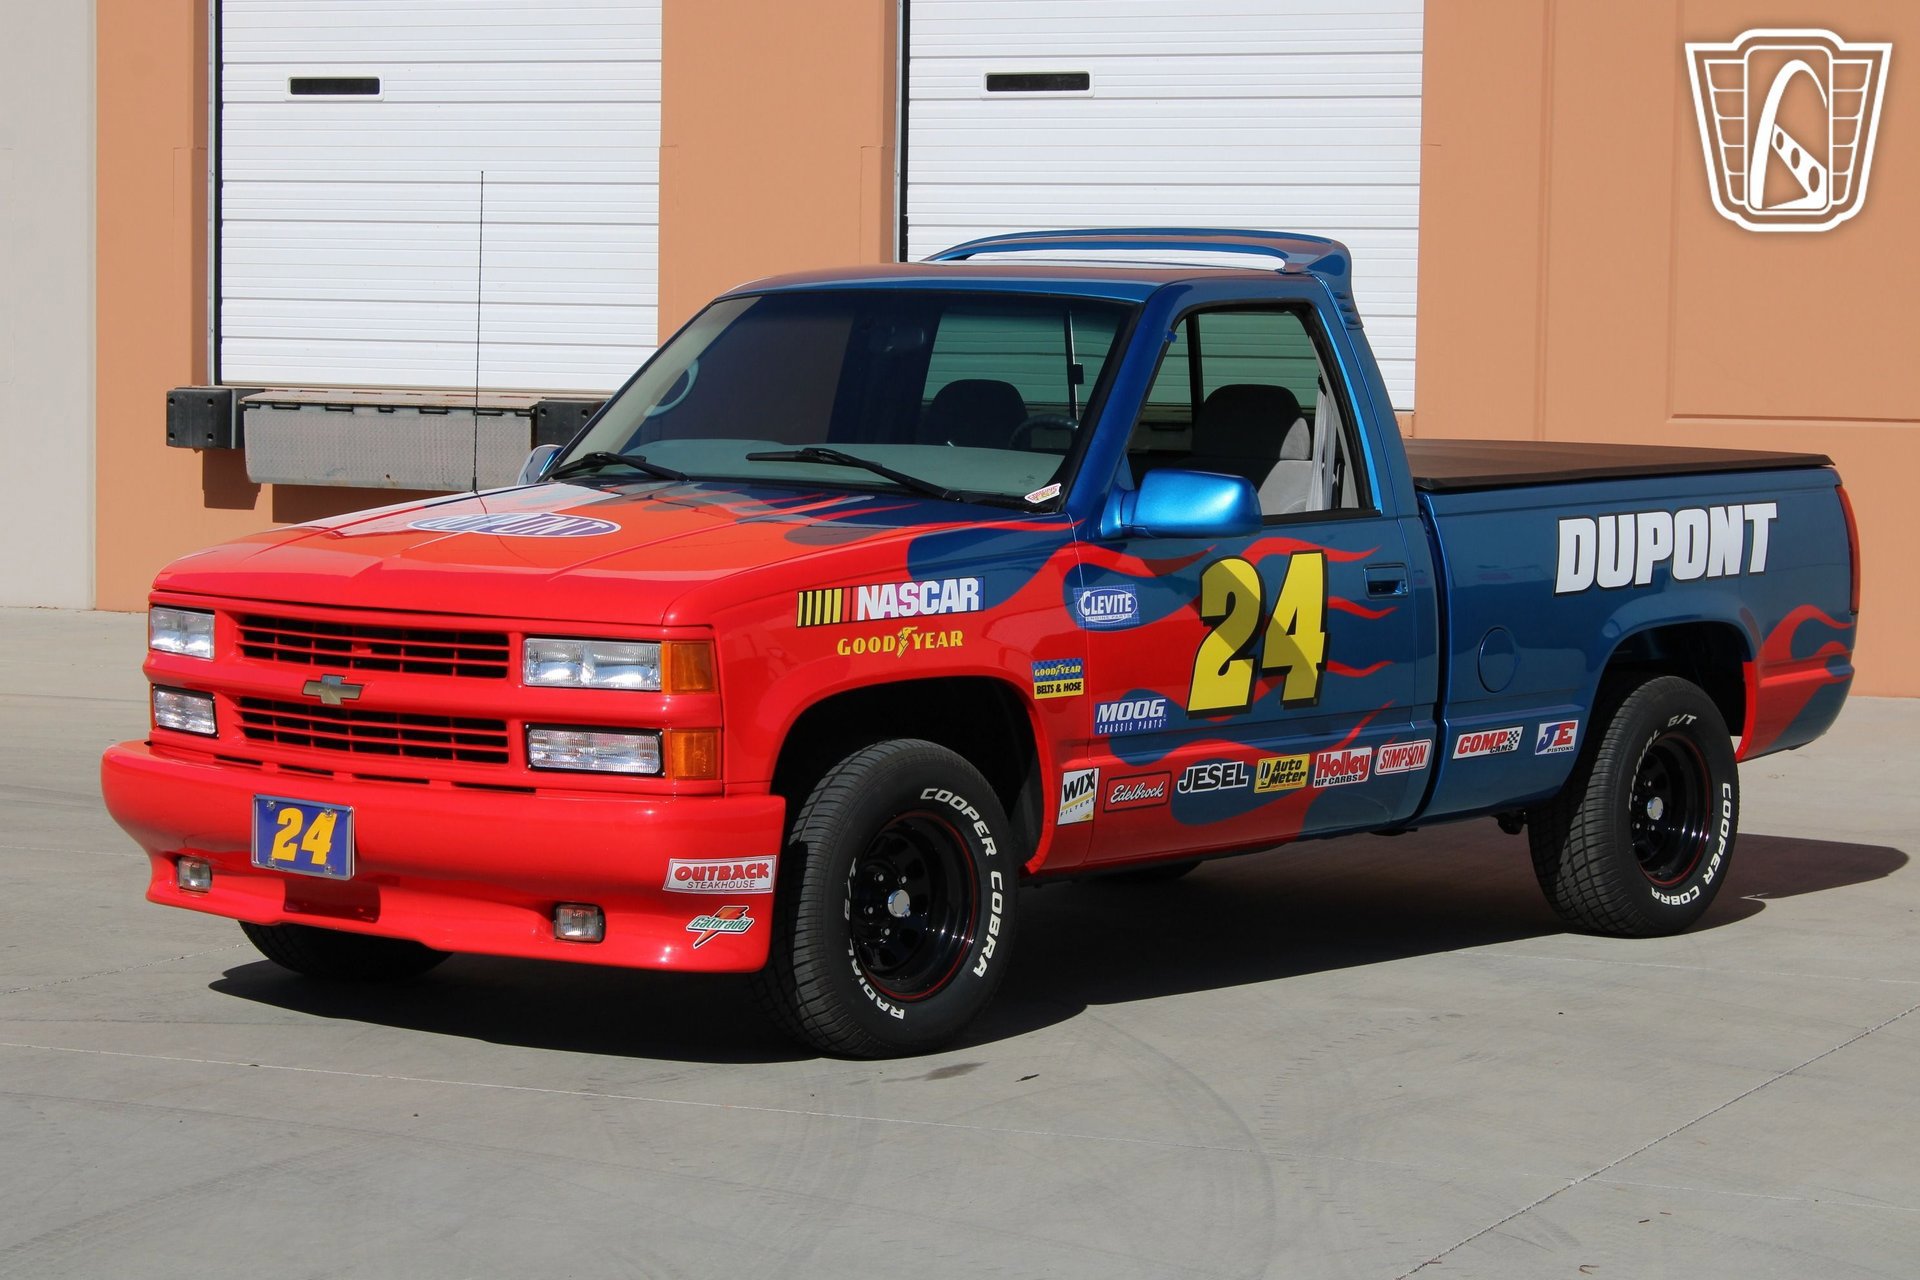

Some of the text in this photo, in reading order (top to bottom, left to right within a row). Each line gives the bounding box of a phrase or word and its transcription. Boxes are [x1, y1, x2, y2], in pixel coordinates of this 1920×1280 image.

[418, 514, 610, 535] DUPONT
[1555, 502, 1777, 594] DUPONT
[857, 577, 979, 621] NASCAR
[1081, 591, 1132, 616] CLEVITE
[1187, 551, 1328, 717] 24
[1037, 682, 1081, 694] BELTS & HOSE
[1096, 699, 1166, 723] MOOG
[1667, 713, 1697, 727] G/T
[1099, 719, 1162, 734] CHASSIS PARTS
[1536, 722, 1576, 753] JE
[1457, 731, 1509, 755] COMP
[1489, 743, 1514, 754] CAMS
[1273, 759, 1303, 773] Auto
[1316, 751, 1370, 781] Holley
[1380, 744, 1428, 770] SIMPSON
[1063, 771, 1095, 802] WIX
[1177, 761, 1248, 794] JESEL
[1270, 770, 1306, 785] Meter
[1314, 778, 1327, 787] HP
[1328, 774, 1358, 785] CARBS
[1110, 781, 1165, 804] Edelbrock
[271, 807, 338, 866] 24
[1651, 782, 1731, 905] COOPER COBRA
[674, 862, 769, 881] OUTBACK
[920, 788, 1003, 978] COOPER COBRA
[687, 880, 755, 889] STEAKHOUSE
[691, 917, 750, 930] Gatorade
[847, 938, 905, 1020] RADIAL
